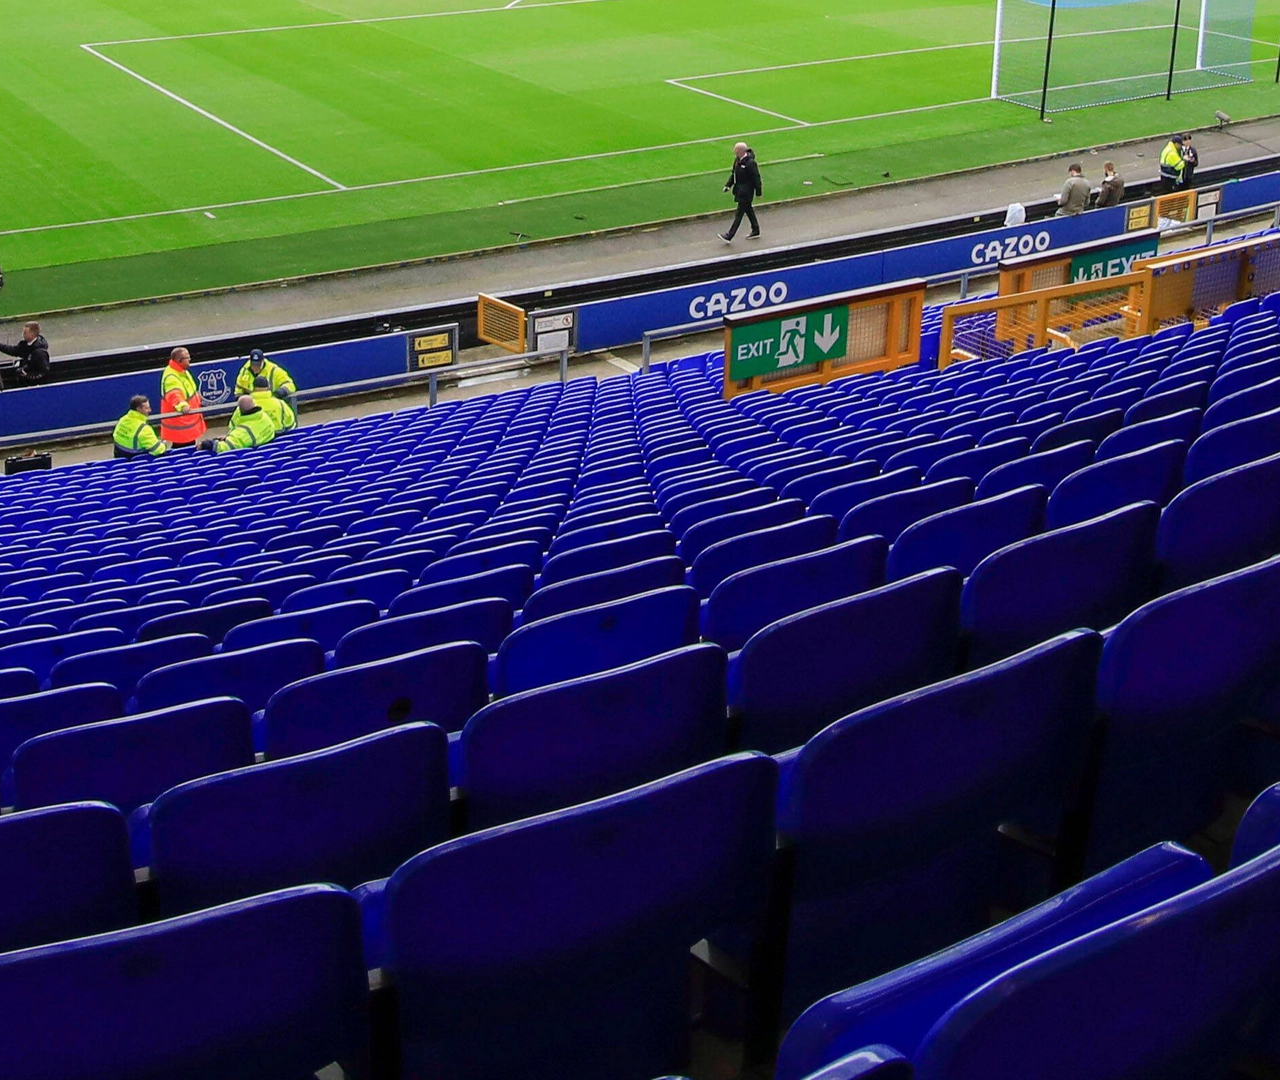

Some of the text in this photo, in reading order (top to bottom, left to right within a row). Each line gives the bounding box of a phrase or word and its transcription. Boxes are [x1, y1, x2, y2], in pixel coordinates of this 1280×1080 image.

[971, 231, 1050, 265] CAZOO
[688, 281, 788, 319] CAZOO
[737, 337, 774, 361] EXIT
[203, 389, 223, 397] Everton
